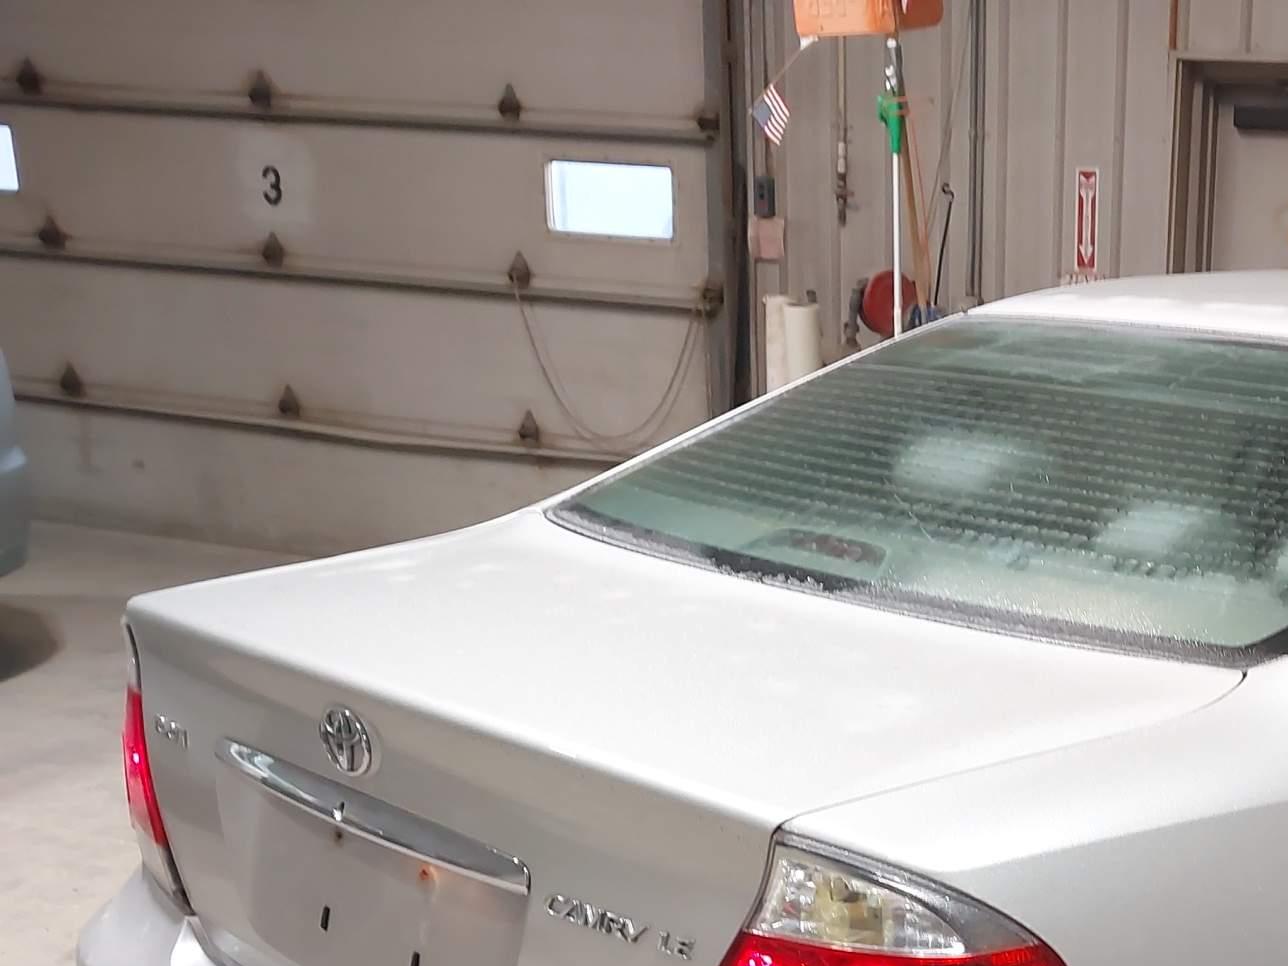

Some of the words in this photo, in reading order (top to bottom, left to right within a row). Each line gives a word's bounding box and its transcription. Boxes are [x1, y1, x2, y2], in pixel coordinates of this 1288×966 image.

[262, 165, 282, 207] 3
[545, 894, 650, 944] CAMRY
[658, 930, 696, 961] LE
